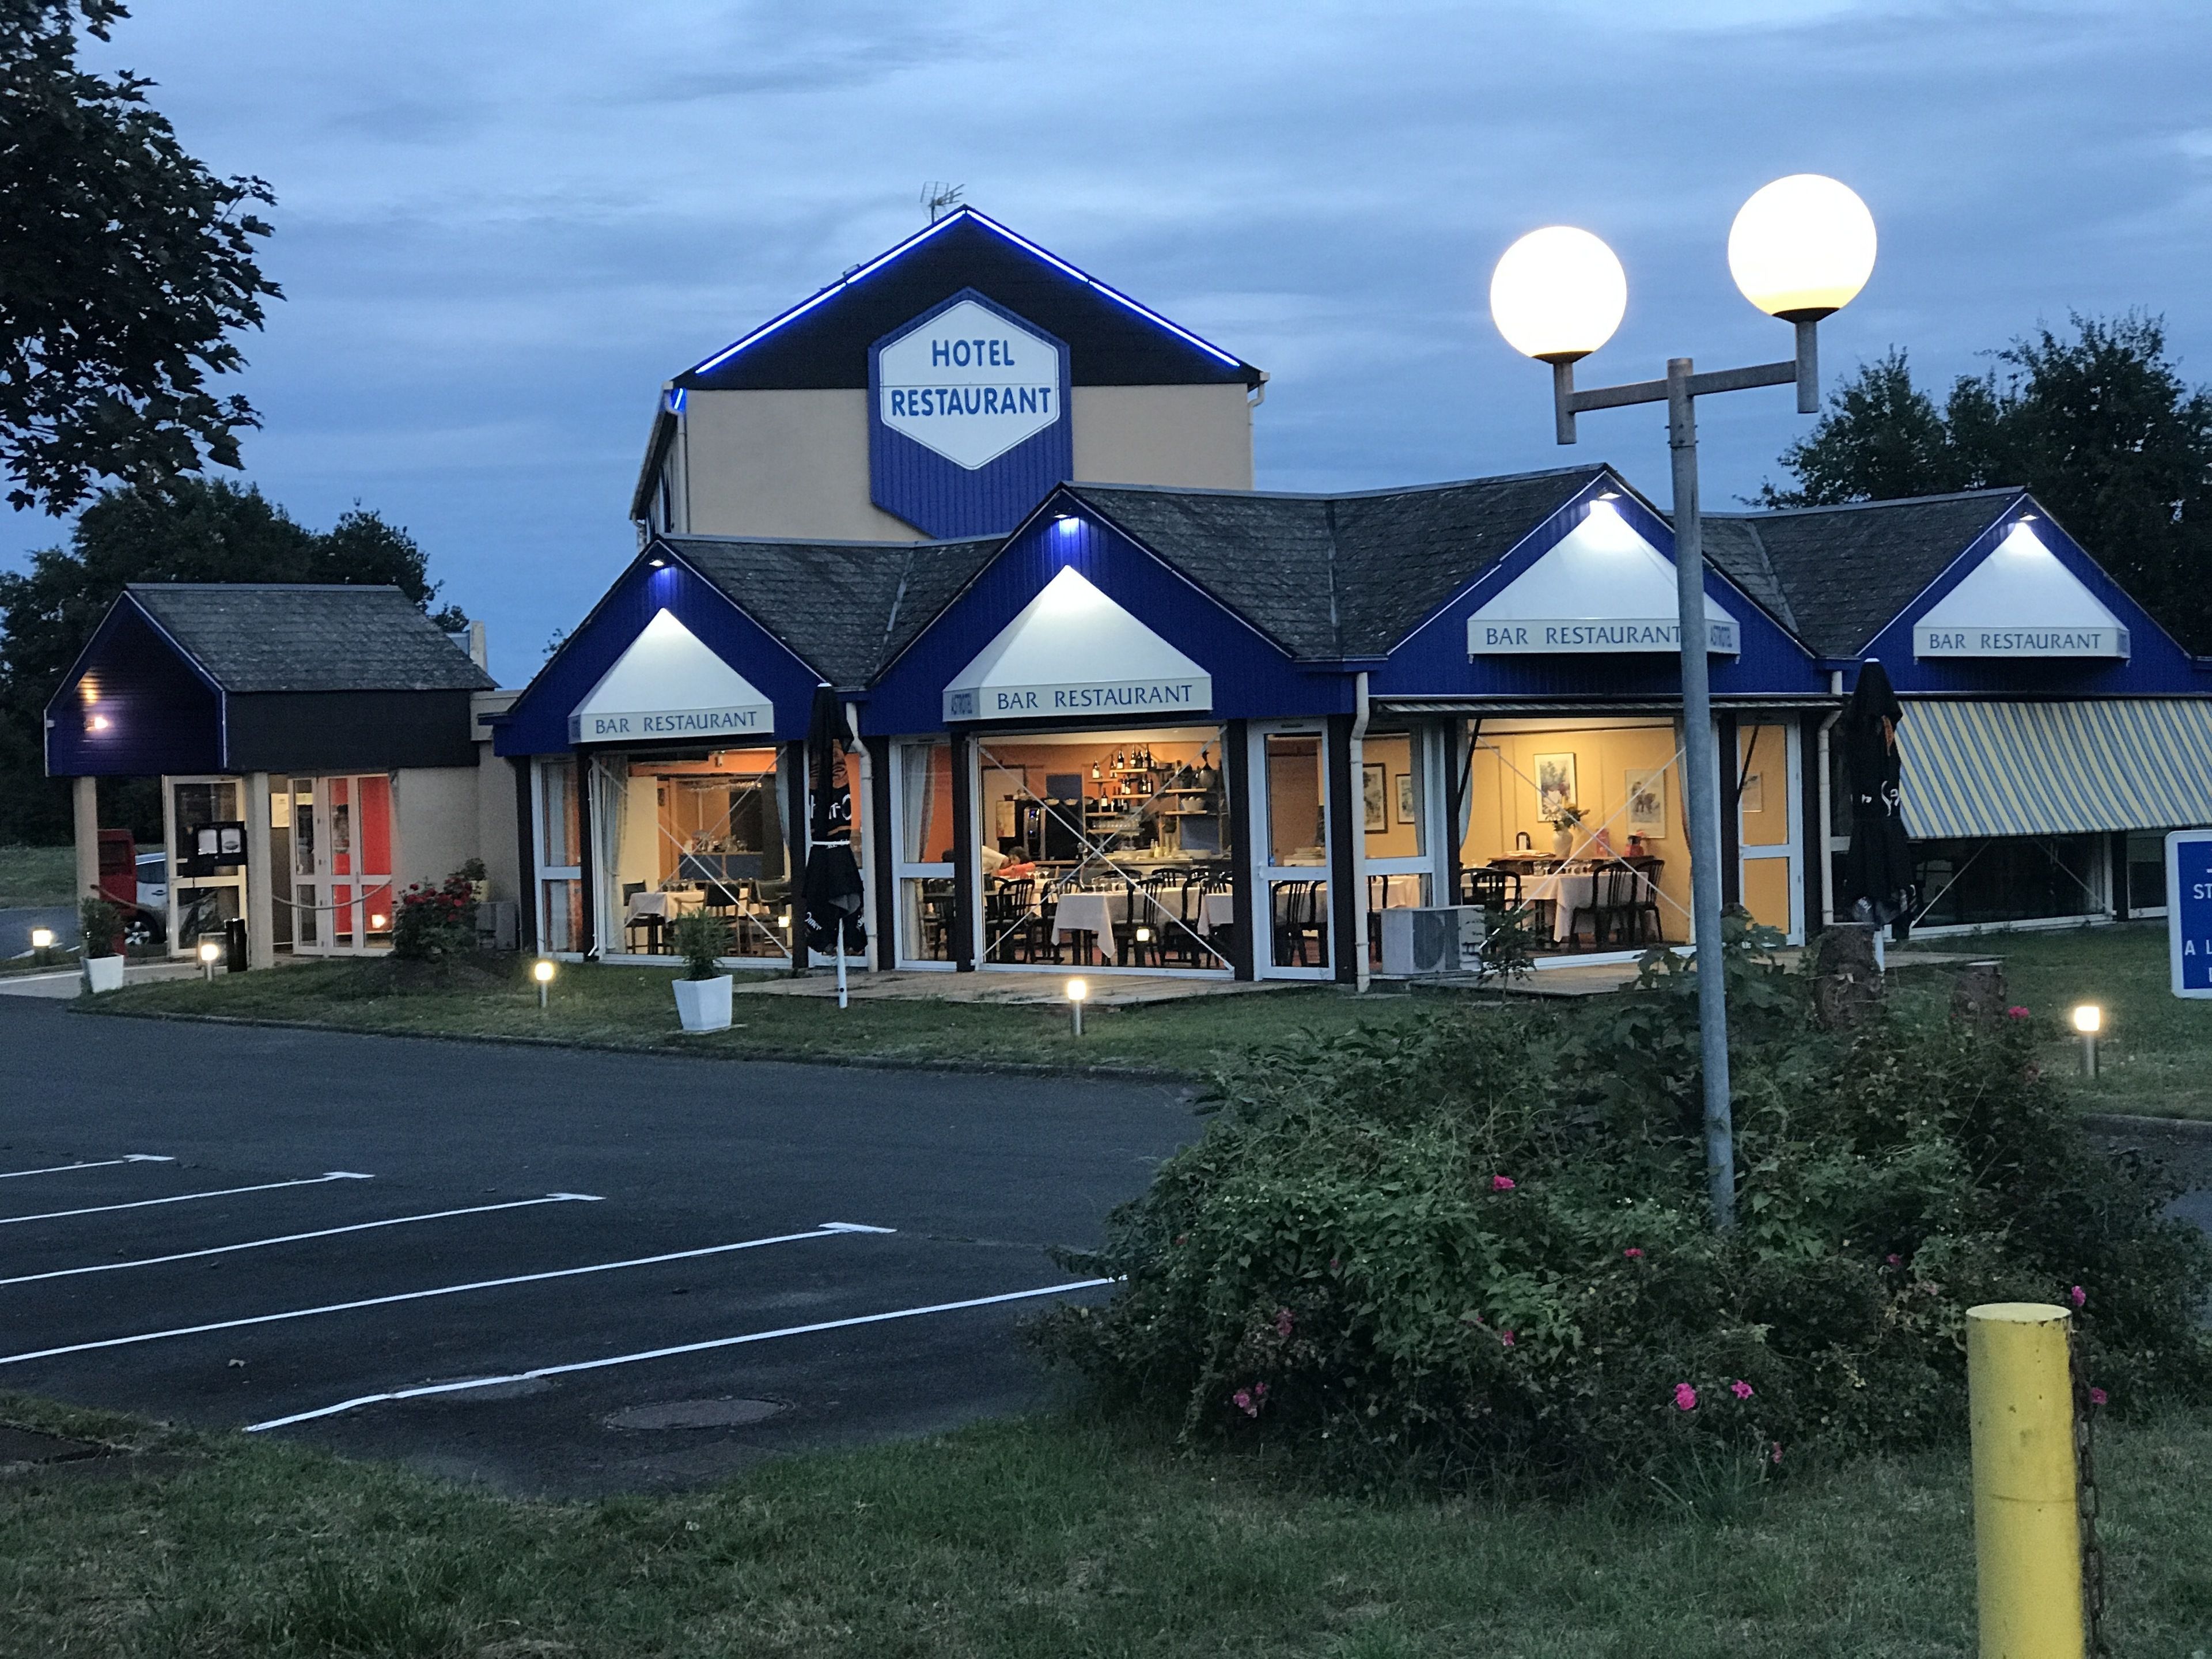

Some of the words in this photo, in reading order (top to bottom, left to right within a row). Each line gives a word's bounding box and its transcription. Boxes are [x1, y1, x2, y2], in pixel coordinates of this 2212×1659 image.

[931, 339, 1015, 366] HOTEL
[891, 387, 1051, 416] RESTAURANT
[1486, 627, 1529, 645] BAR
[1546, 626, 1680, 644] RESTAURANT
[1930, 634, 1966, 649] BAR
[1980, 634, 2101, 649] RESTAURANT
[998, 692, 1039, 710] BAR
[1055, 685, 1193, 708] RESTAURANT
[596, 718, 630, 734] BAR
[644, 711, 757, 732] RESTAURANT
[2185, 940, 2196, 956] A
